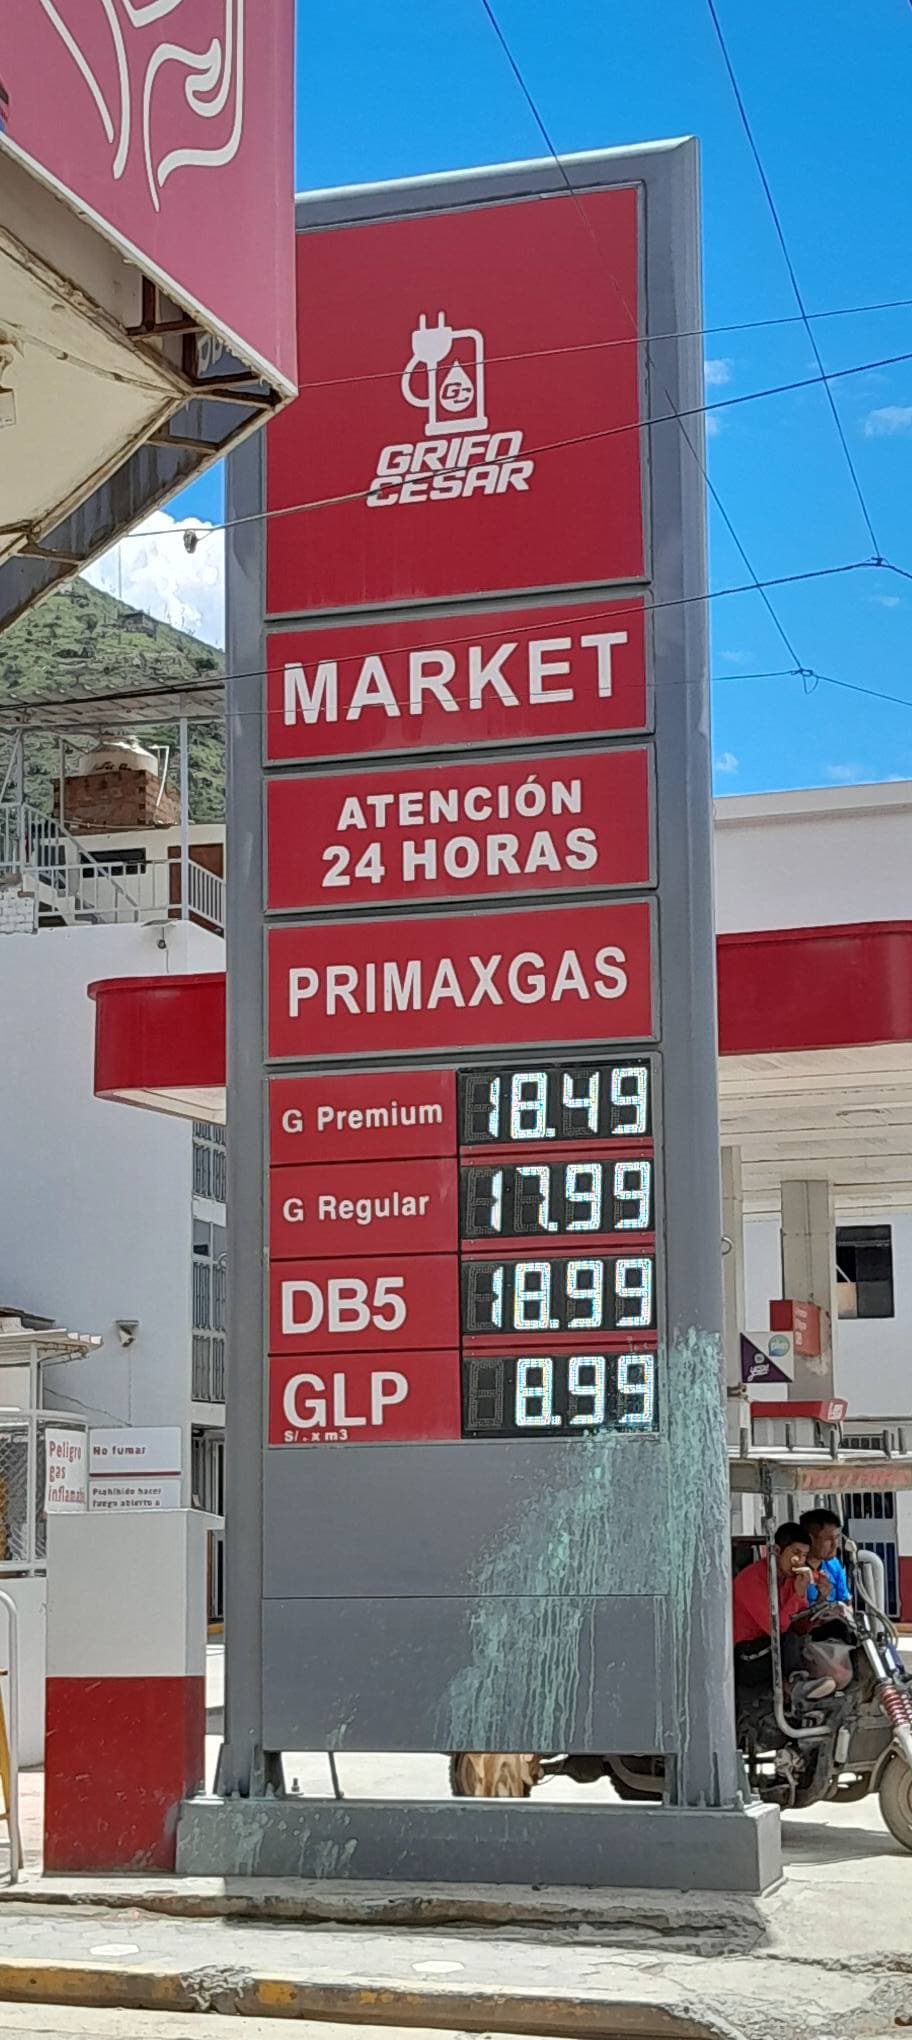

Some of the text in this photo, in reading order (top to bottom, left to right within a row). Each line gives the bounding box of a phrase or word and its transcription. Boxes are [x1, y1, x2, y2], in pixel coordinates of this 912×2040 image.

[376, 431, 523, 476] GRIFO
[366, 460, 534, 507] CESAR
[283, 631, 629, 726] MARKET
[336, 775, 582, 831] ATENCIÓN
[322, 827, 599, 887] 24 HORAS
[288, 946, 628, 1018] PRIMAXGAS
[282, 1101, 443, 1133] G Premium
[489, 1066, 648, 1140] 18.49
[282, 1191, 430, 1225] G Regular
[491, 1160, 651, 1232] 17.99
[281, 1276, 407, 1335] DB5
[492, 1258, 652, 1330] 18.99
[283, 1371, 409, 1428] GLP
[515, 1354, 655, 1426] 8.99
[49, 1441, 82, 1463] Peligro
[93, 1446, 147, 1455] No fumar
[324, 1428, 348, 1441] m3
[49, 1466, 66, 1482] gas
